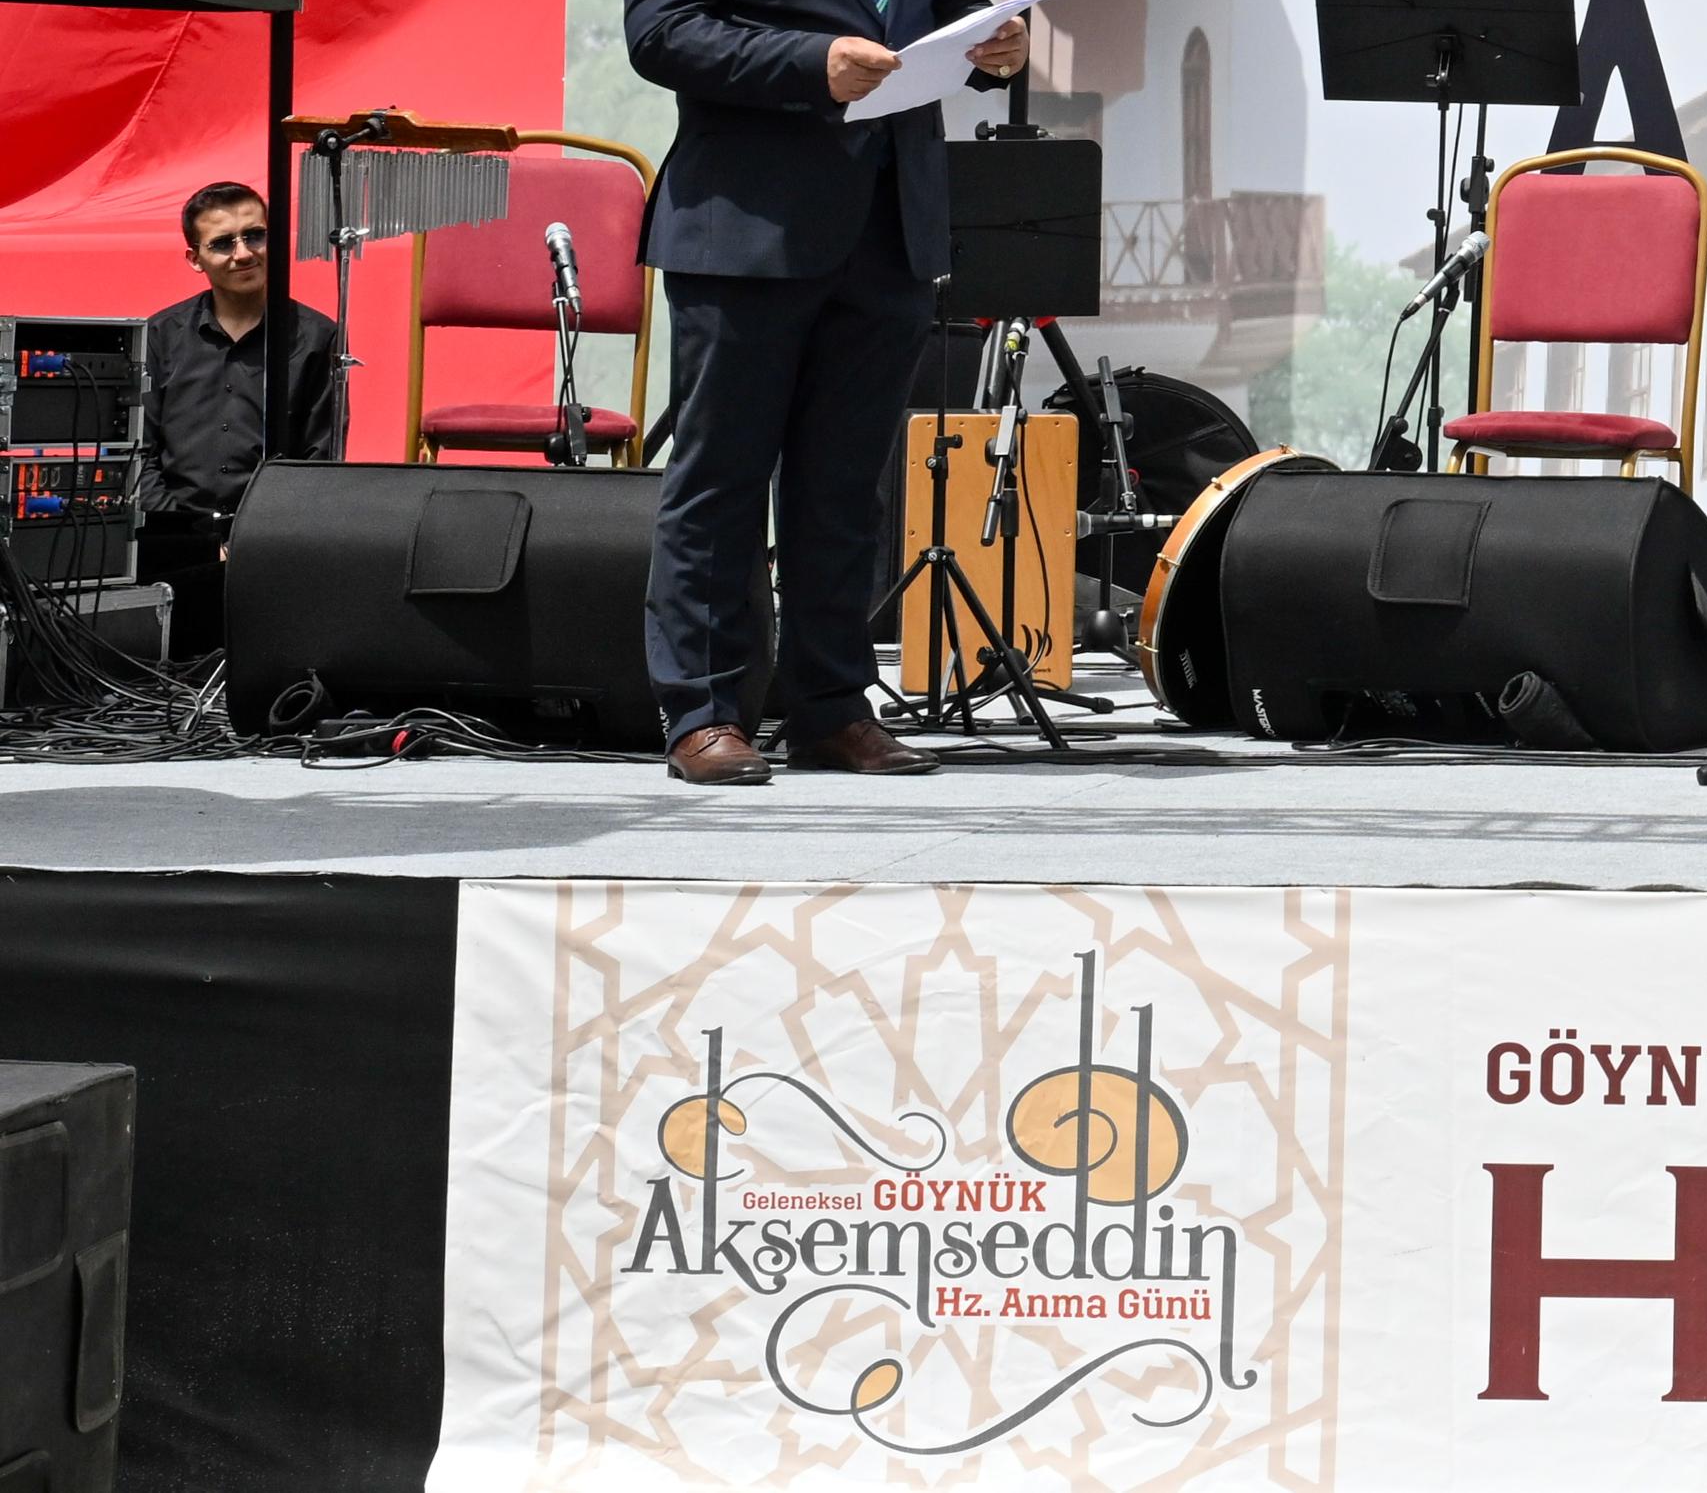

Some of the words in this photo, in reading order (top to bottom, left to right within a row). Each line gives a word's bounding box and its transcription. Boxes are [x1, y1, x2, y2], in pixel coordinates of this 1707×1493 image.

[742, 1191, 863, 1211] Geleneksel
[873, 1172, 1048, 1213] GÖYNÜK
[935, 1287, 992, 1319] Hz.
[1000, 1287, 1107, 1320] Anma
[1117, 1287, 1213, 1322] Günü
